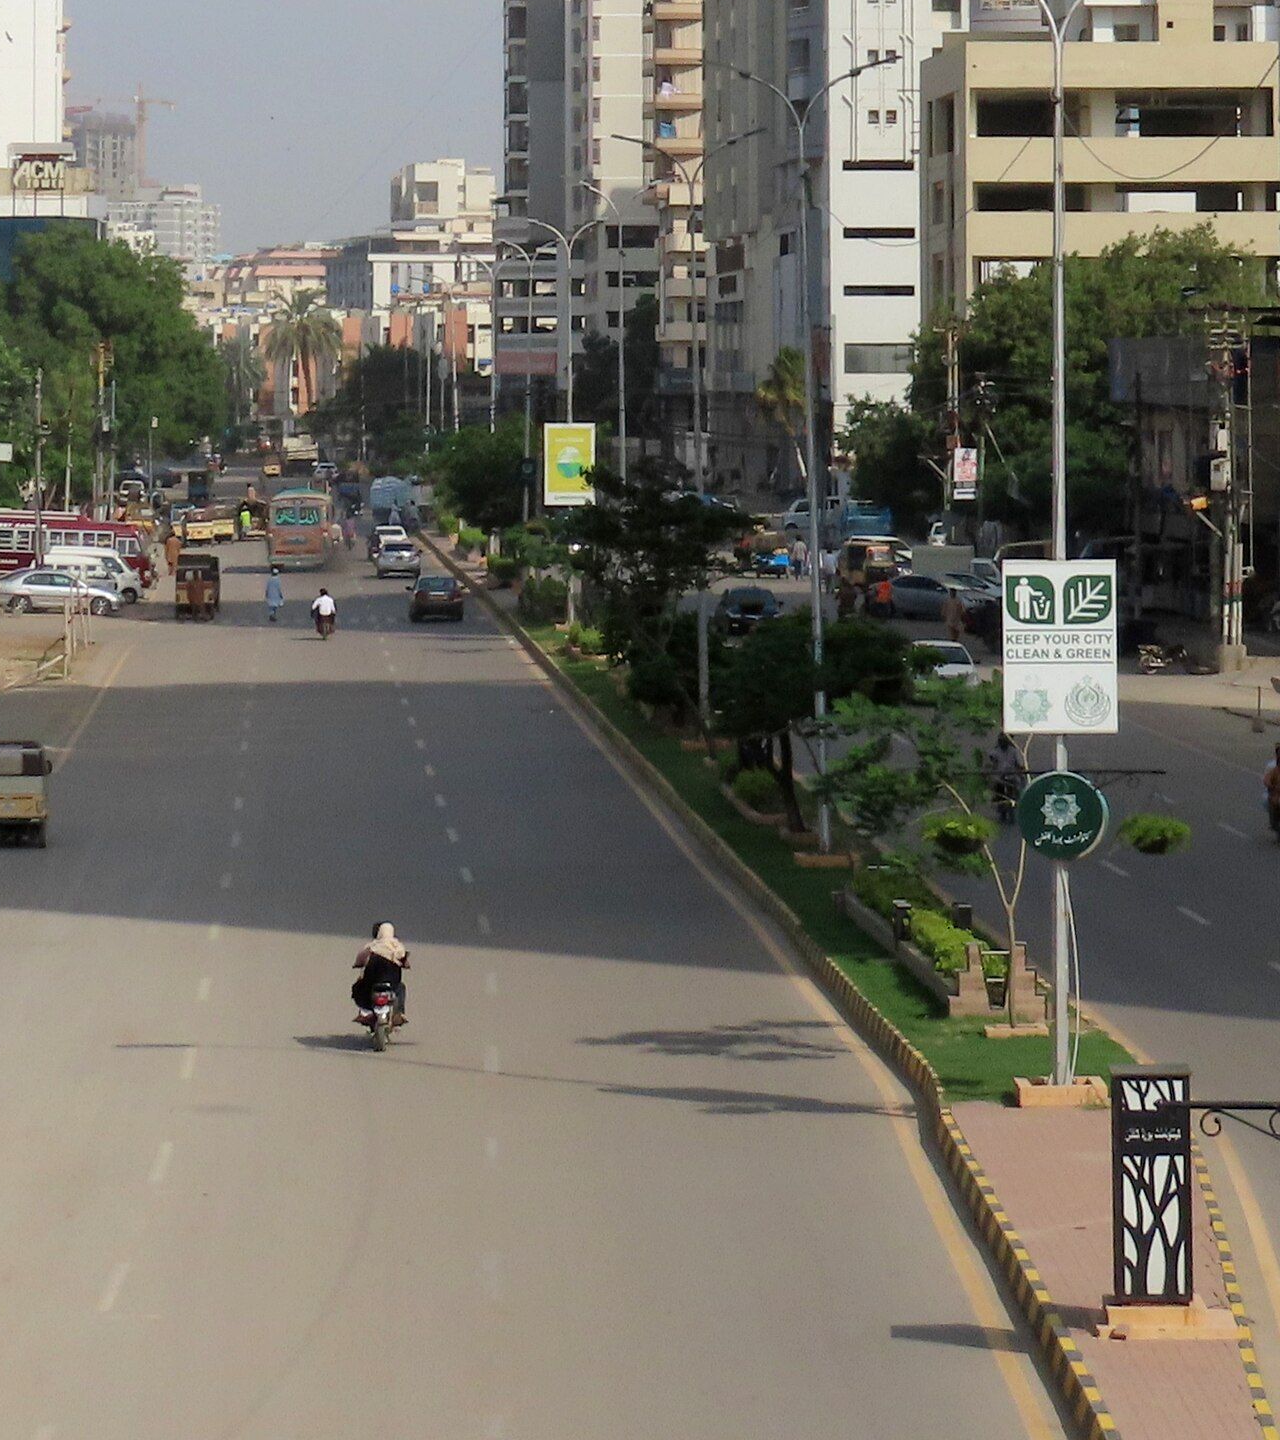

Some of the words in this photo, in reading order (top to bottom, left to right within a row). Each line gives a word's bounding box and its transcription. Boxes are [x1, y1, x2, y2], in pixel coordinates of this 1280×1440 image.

[13, 160, 64, 187] ACM
[1006, 633, 1040, 645] KEEP
[1043, 633, 1080, 645] YOUR
[1084, 633, 1113, 645] CITY
[1006, 648, 1049, 659] CLEAN
[1053, 648, 1062, 659] &
[1066, 648, 1111, 659] GREEN
